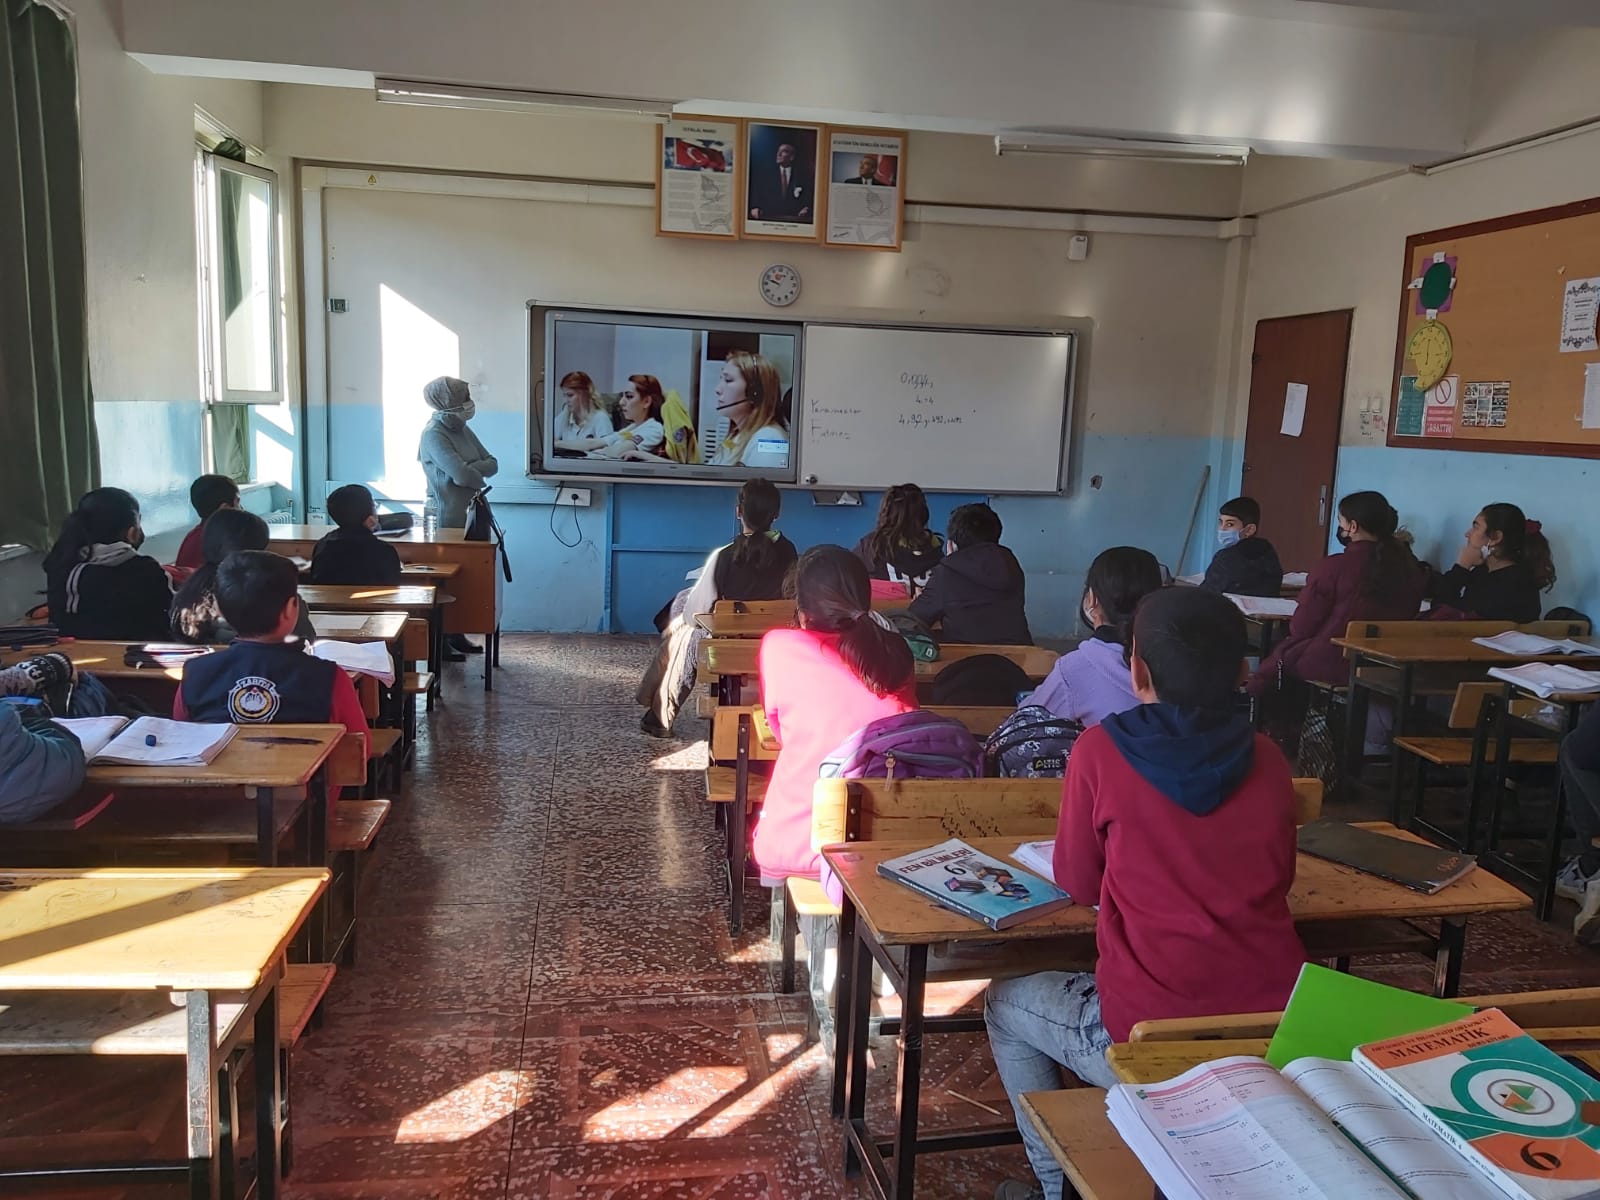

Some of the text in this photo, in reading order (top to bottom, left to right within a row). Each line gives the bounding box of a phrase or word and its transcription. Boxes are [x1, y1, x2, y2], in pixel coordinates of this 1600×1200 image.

[899, 863, 925, 874] FEN
[944, 864, 967, 875] 6
[1388, 1027, 1490, 1059] MATEMATİK
[1422, 1112, 1457, 1146] MATEMATİK
[1521, 1141, 1561, 1171] 6
